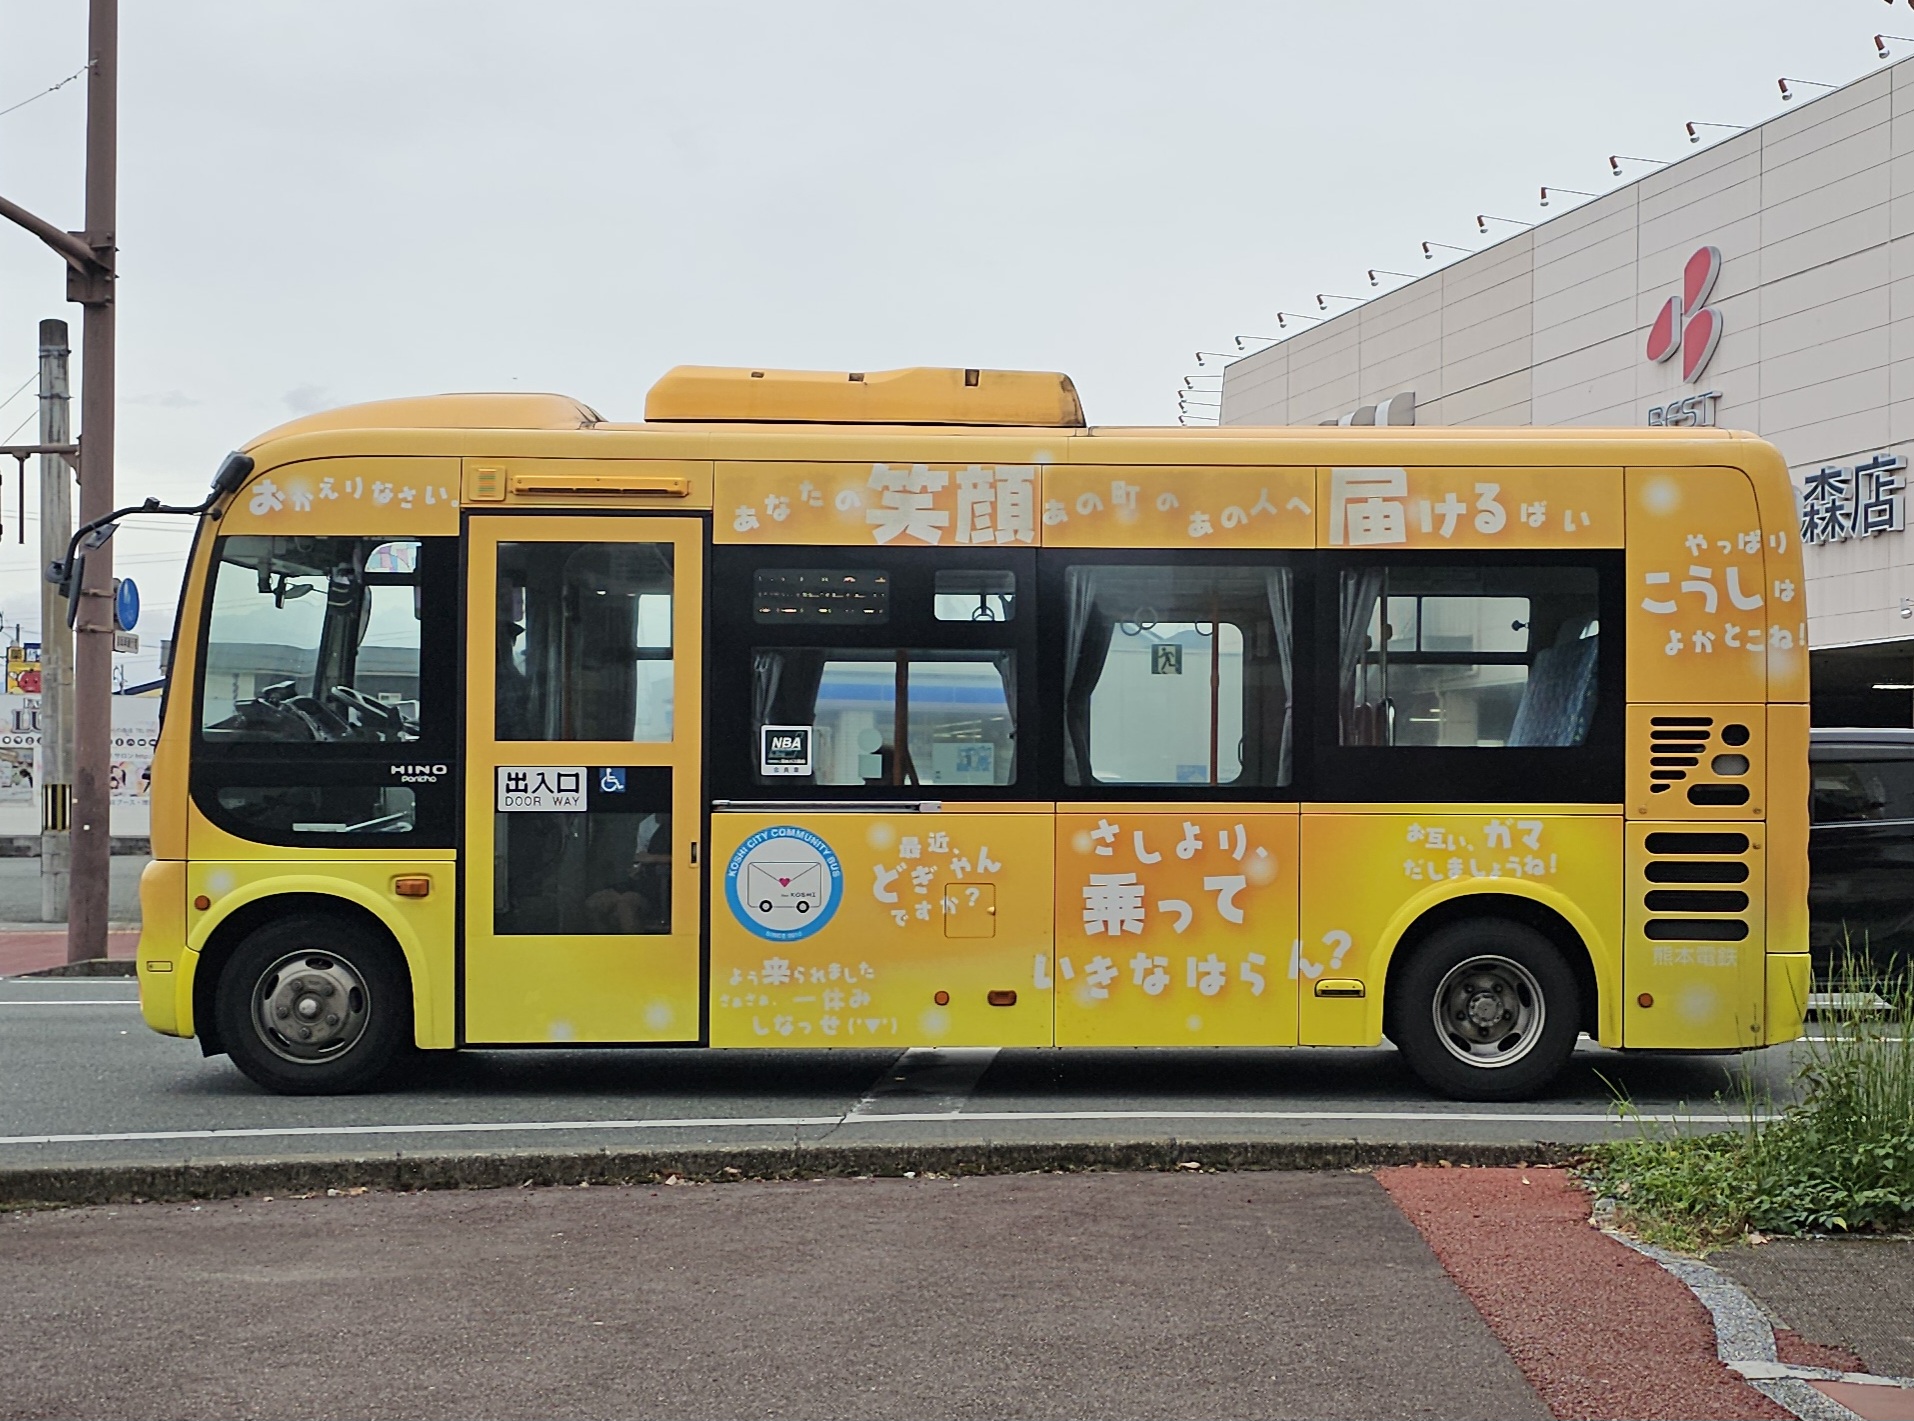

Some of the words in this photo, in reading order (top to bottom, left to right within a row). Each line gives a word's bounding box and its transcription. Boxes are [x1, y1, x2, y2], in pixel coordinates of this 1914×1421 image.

[771, 737, 802, 750] NBA
[391, 765, 447, 774] HINO
[505, 772, 580, 794] 出入口
[505, 796, 542, 807] DOOR
[552, 796, 580, 807] WAY
[728, 846, 749, 877] KOSHI
[747, 831, 769, 848] CITY
[770, 828, 832, 855] COMMUNITY
[827, 856, 841, 878] BUS
[1082, 873, 1246, 936] 乗って
